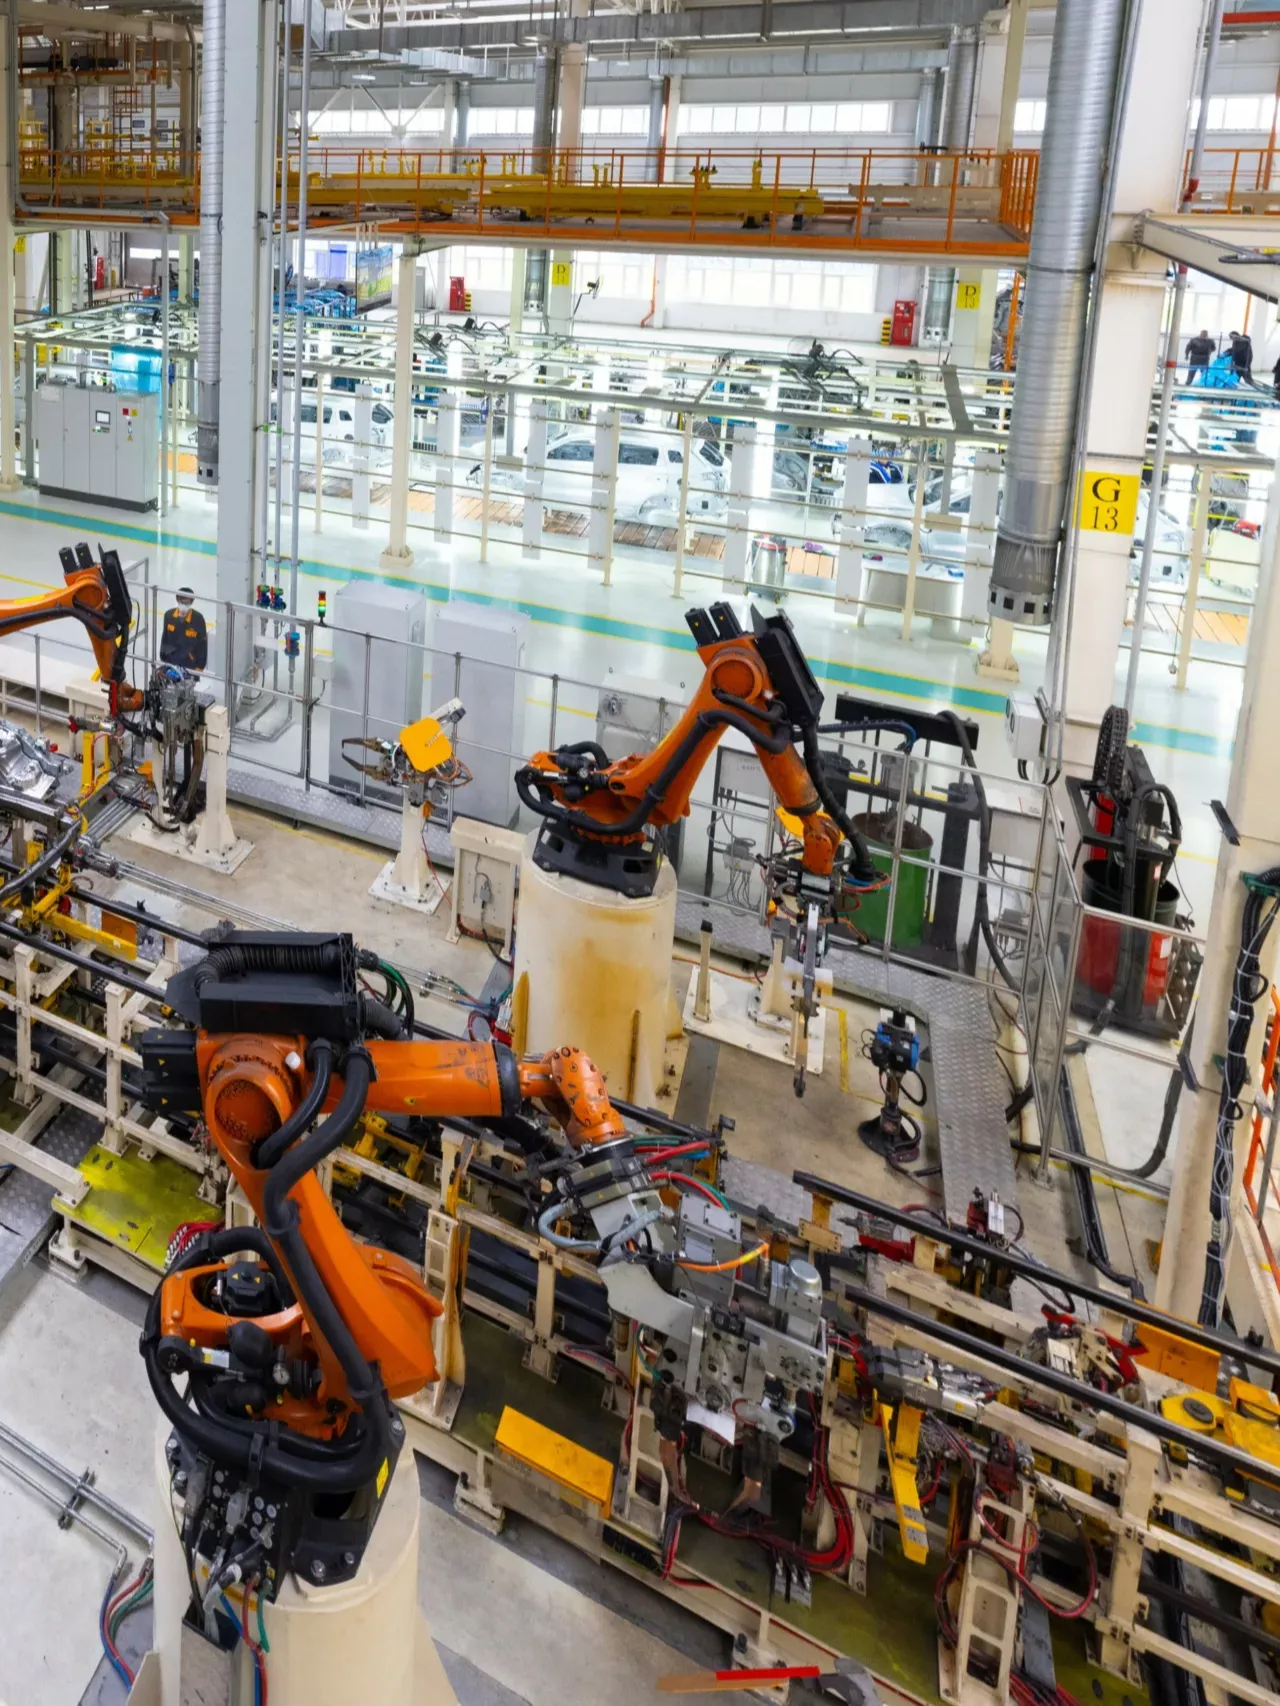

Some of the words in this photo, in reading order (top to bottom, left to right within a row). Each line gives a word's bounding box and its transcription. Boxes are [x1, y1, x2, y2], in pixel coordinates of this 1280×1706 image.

[965, 284, 977, 297] D
[1092, 477, 1122, 503] G
[1091, 506, 1119, 532] 13
